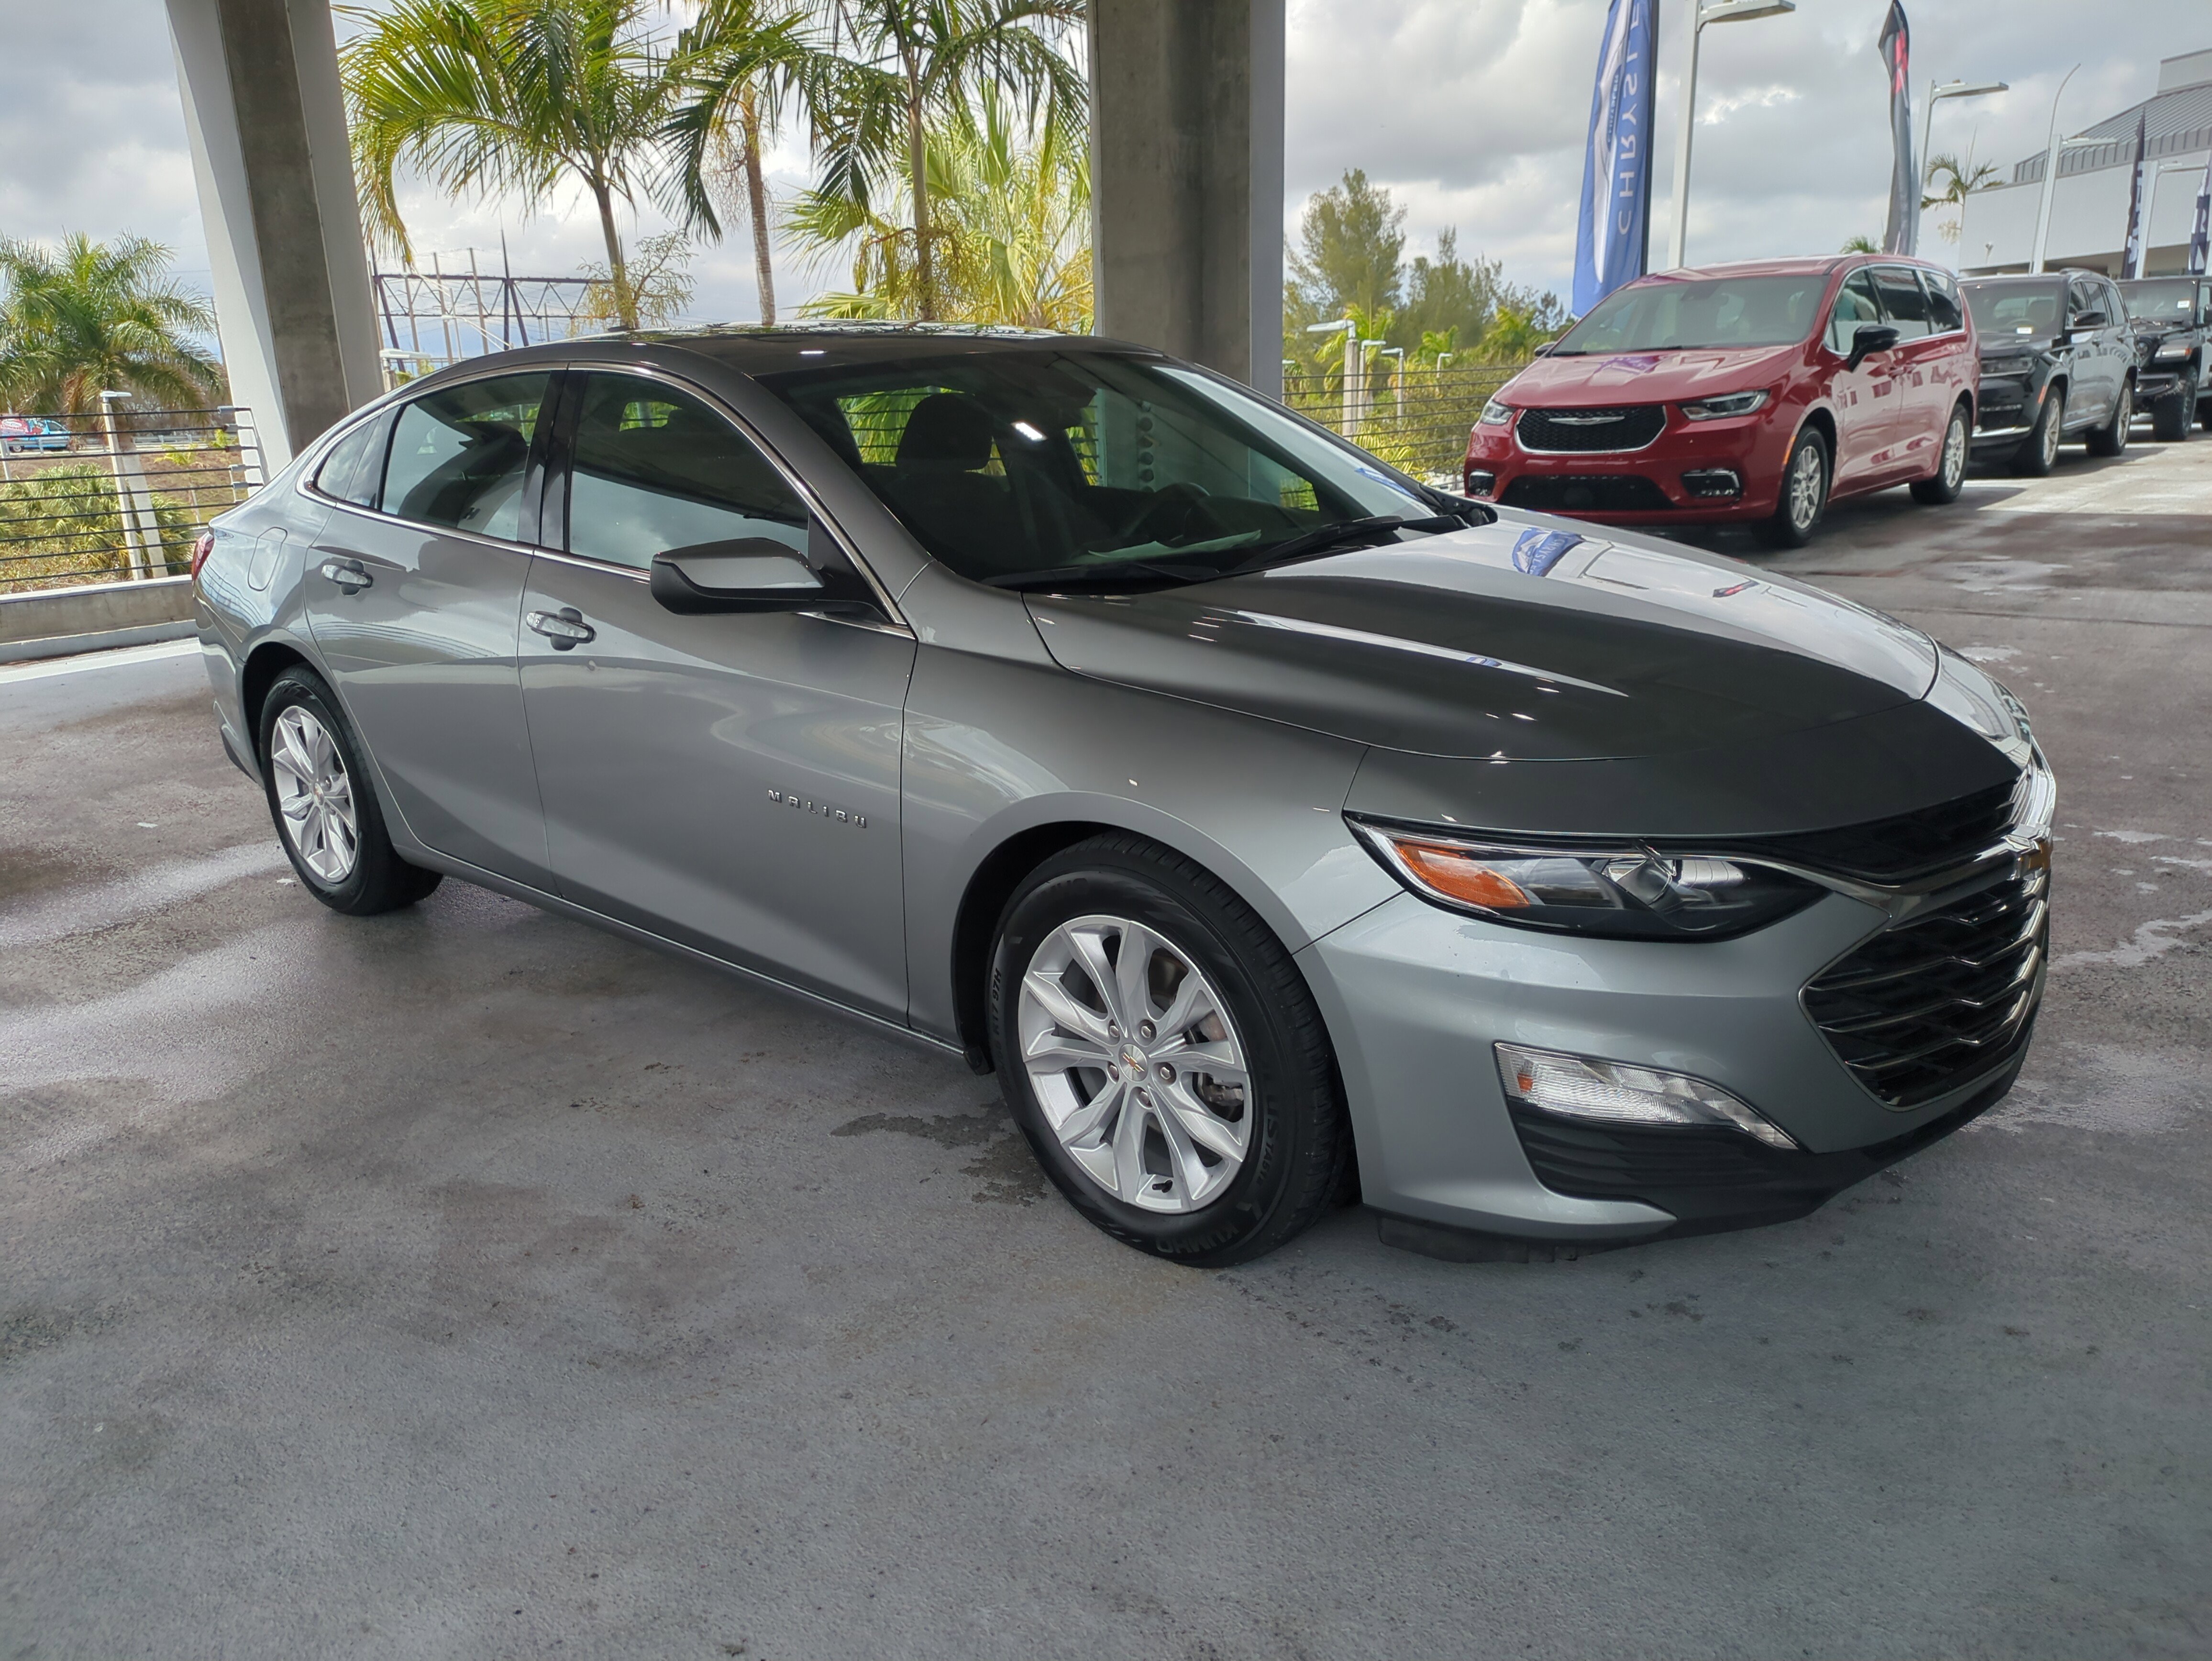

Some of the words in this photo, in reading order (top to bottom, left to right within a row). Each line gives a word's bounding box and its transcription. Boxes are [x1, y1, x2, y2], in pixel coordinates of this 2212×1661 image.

[767, 789, 867, 829] MALIBU
[992, 967, 1002, 1001] 97H
[1155, 1222, 1239, 1254] KUMHO
